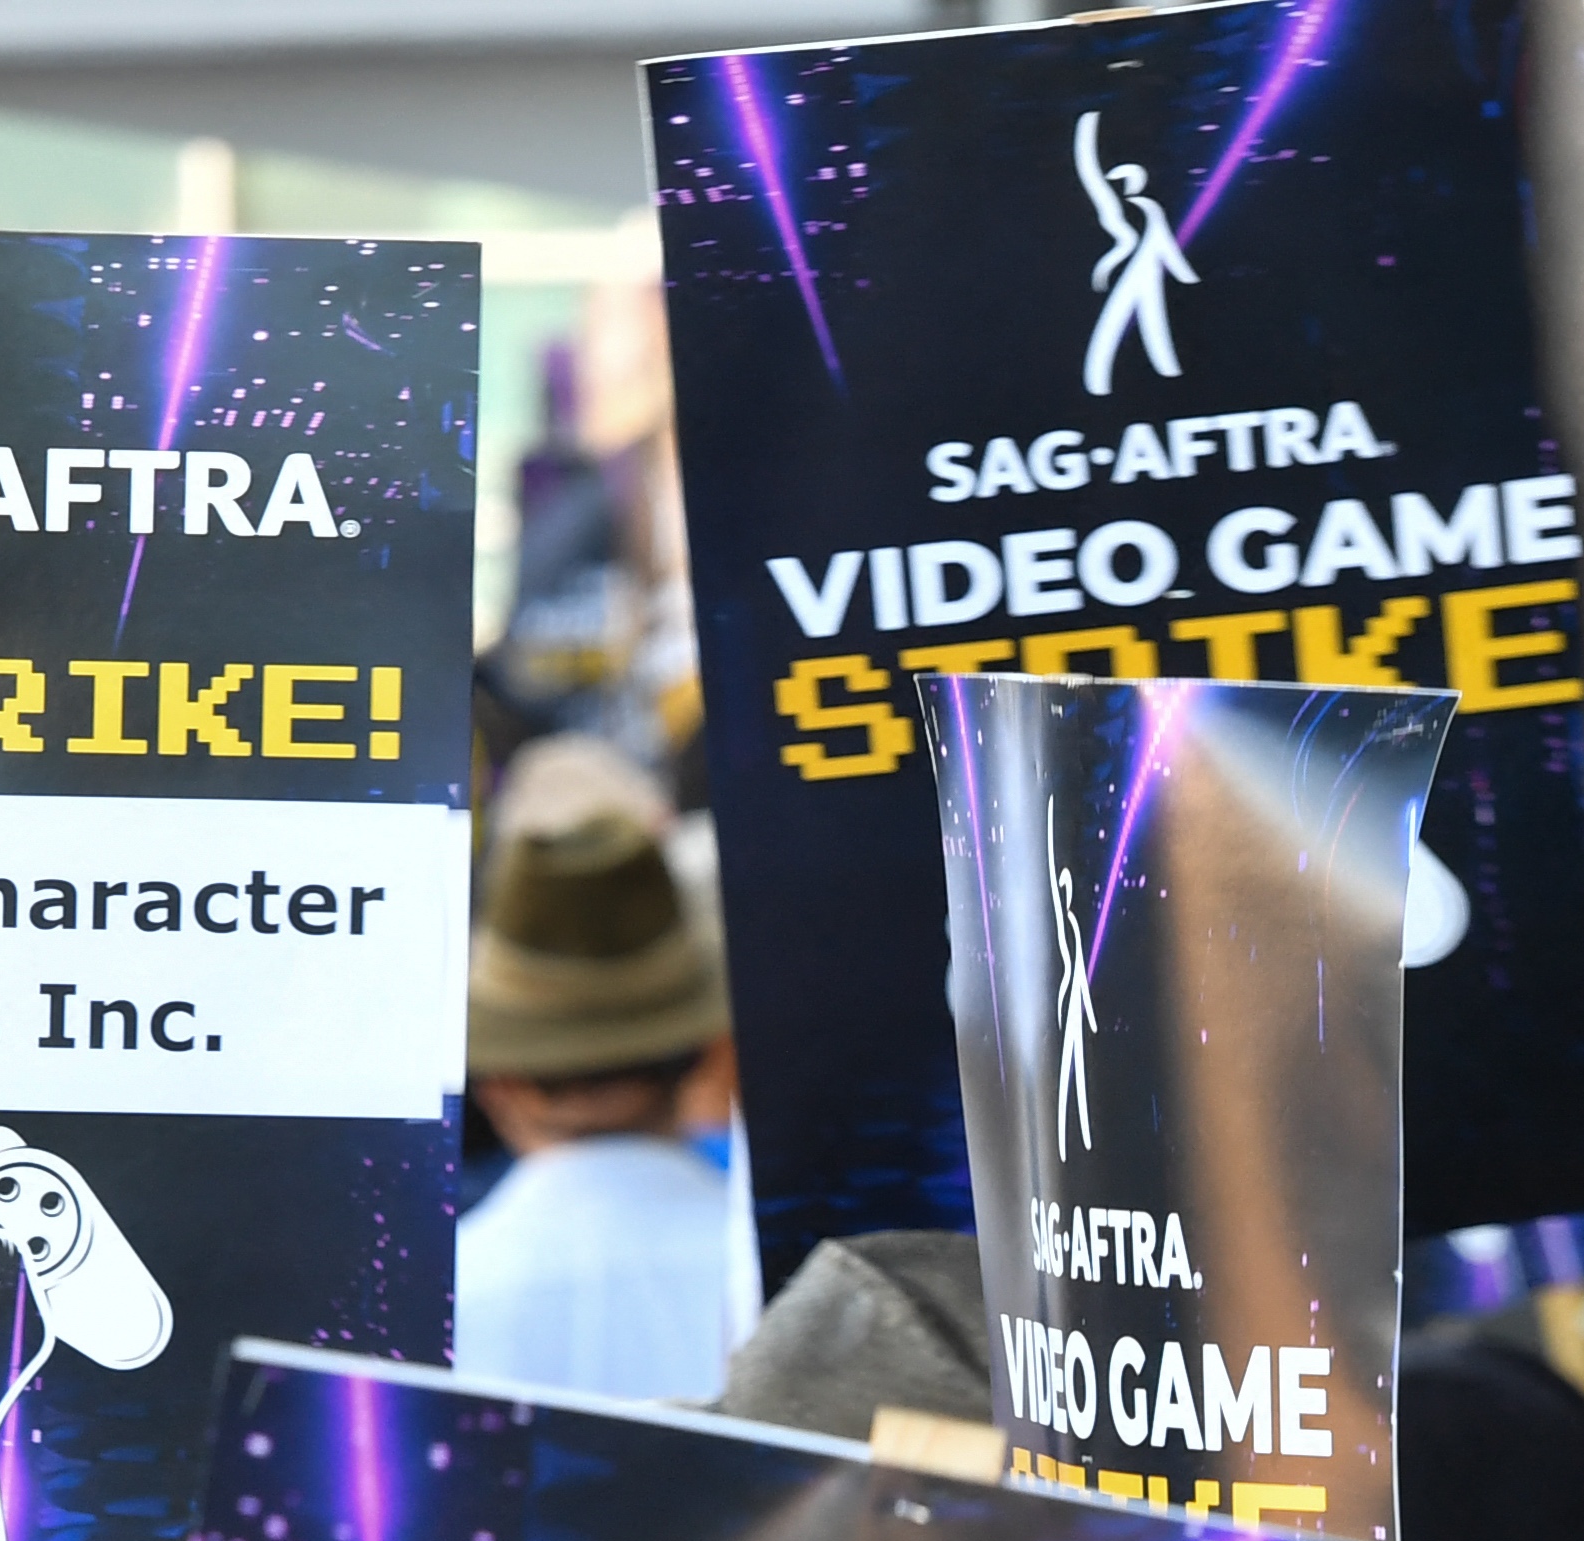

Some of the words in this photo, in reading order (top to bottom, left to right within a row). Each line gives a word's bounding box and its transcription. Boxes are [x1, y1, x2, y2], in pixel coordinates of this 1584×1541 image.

[766, 519, 1180, 639] VIDEO
[1206, 473, 1584, 594] GAME
[36, 981, 223, 1052] Inc.
[999, 1313, 1098, 1440] VIDEO
[1108, 1335, 1333, 1457] GAME
